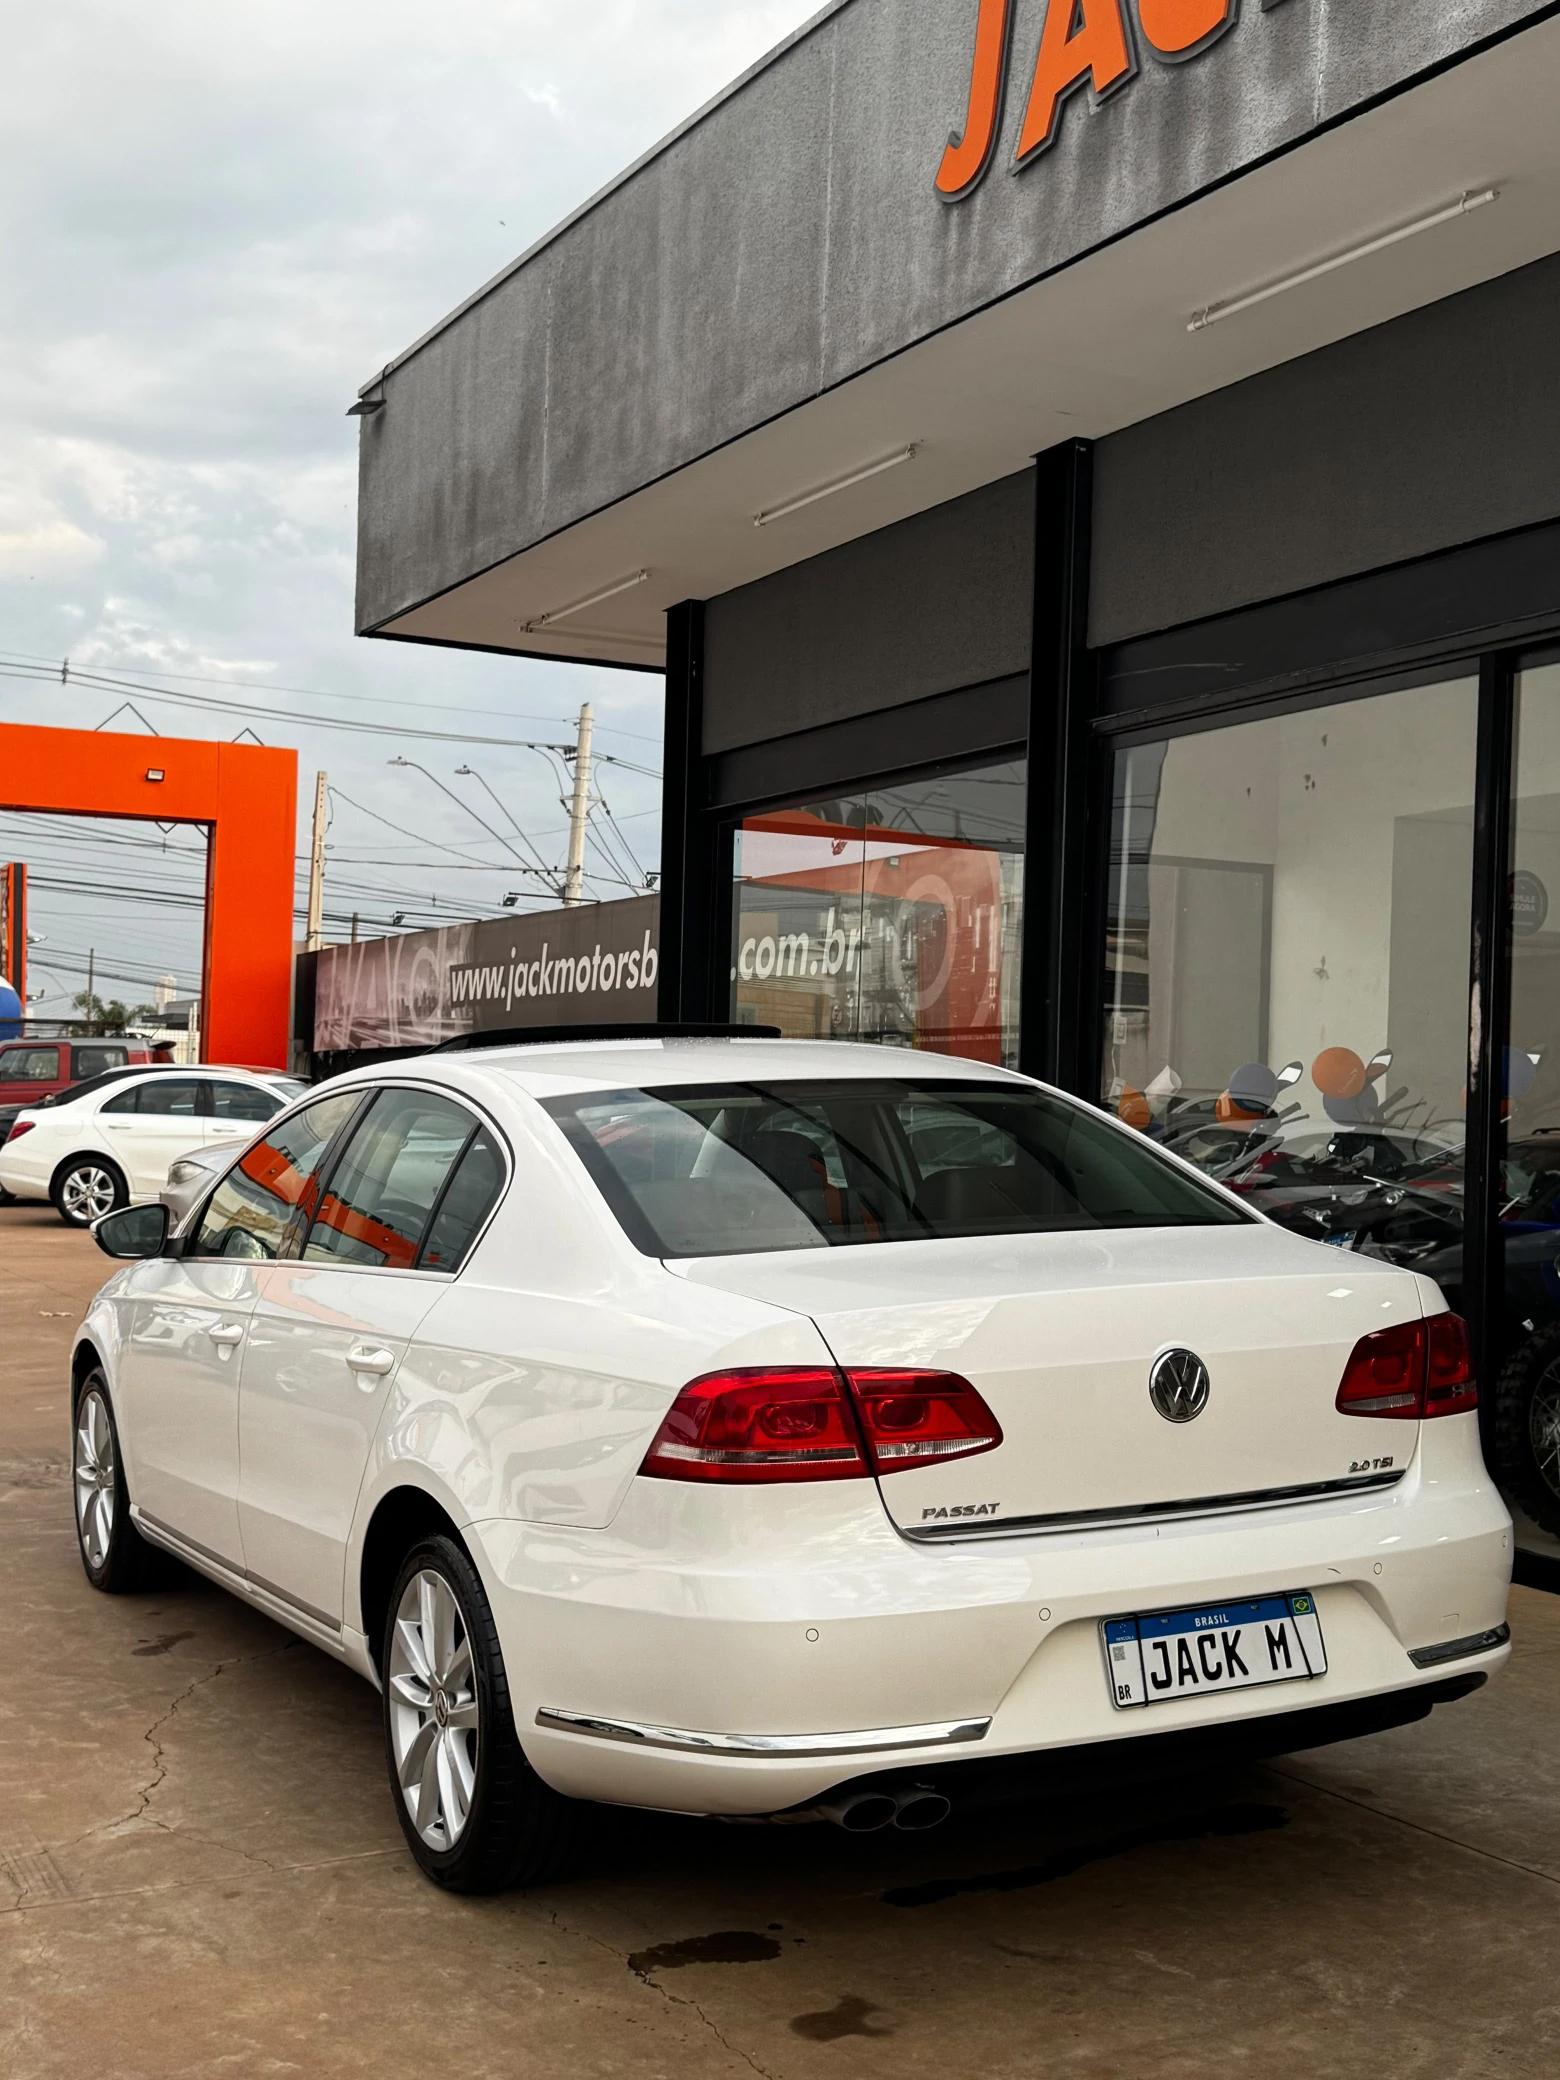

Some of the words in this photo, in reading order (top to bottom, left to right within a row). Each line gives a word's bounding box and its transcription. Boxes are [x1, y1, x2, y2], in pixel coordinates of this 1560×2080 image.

[937, 0, 1240, 203] JA
[1348, 1460, 1370, 1473] 2.0
[1372, 1456, 1394, 1470] TSI
[921, 1503, 1001, 1520] PASSAT
[1194, 1613, 1230, 1627] BRASIL
[1150, 1629, 1249, 1690] JACK
[1264, 1622, 1293, 1671] M
[1117, 1684, 1132, 1700] BR
